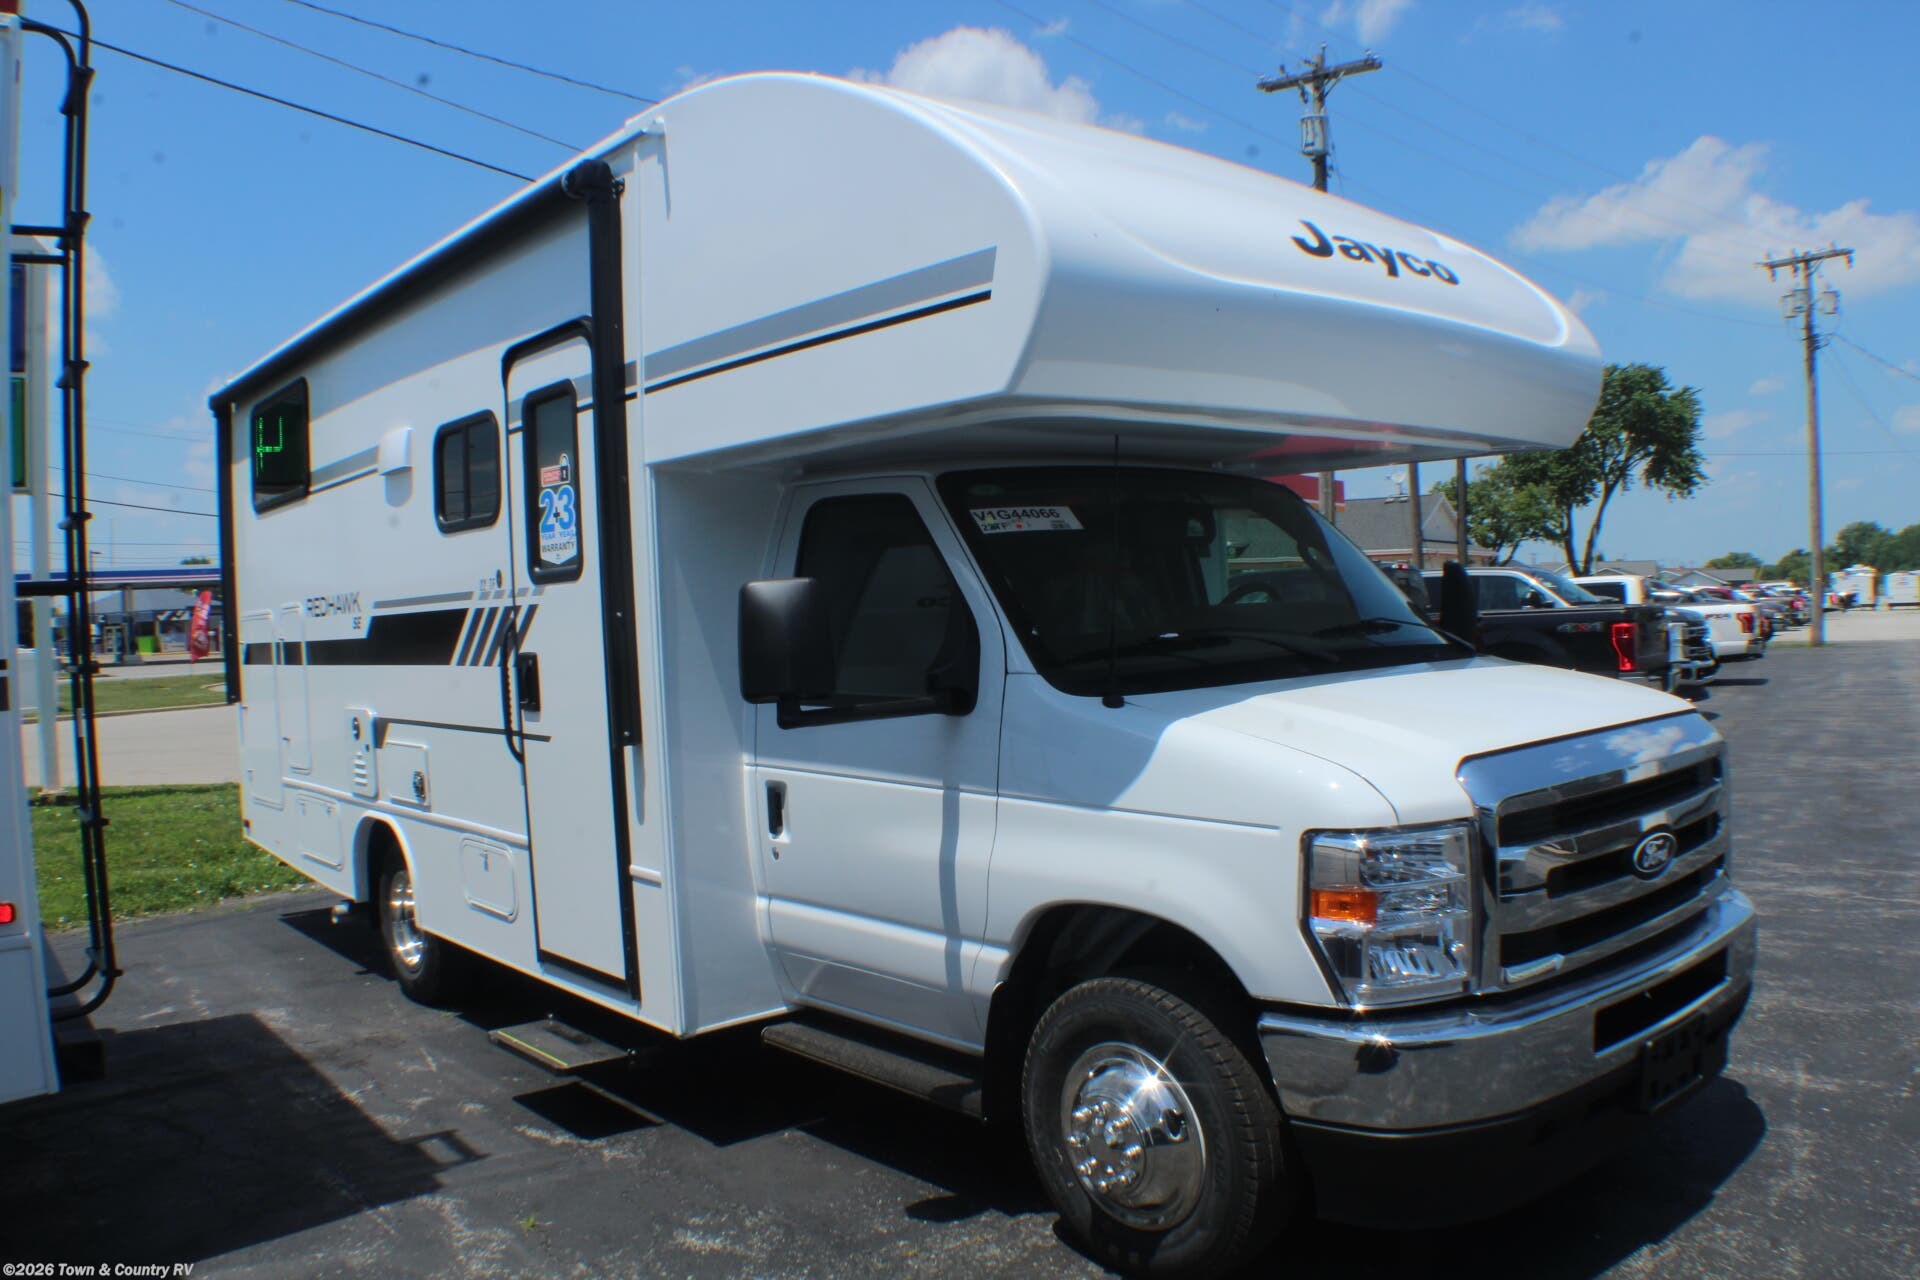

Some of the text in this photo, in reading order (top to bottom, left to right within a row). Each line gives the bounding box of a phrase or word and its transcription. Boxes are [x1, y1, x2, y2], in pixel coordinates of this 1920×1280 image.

[1289, 219, 1460, 286] Jayco
[972, 507, 1060, 522] V1G44066
[541, 541, 575, 553] WARRANTY
[305, 591, 362, 618] REDHAWK
